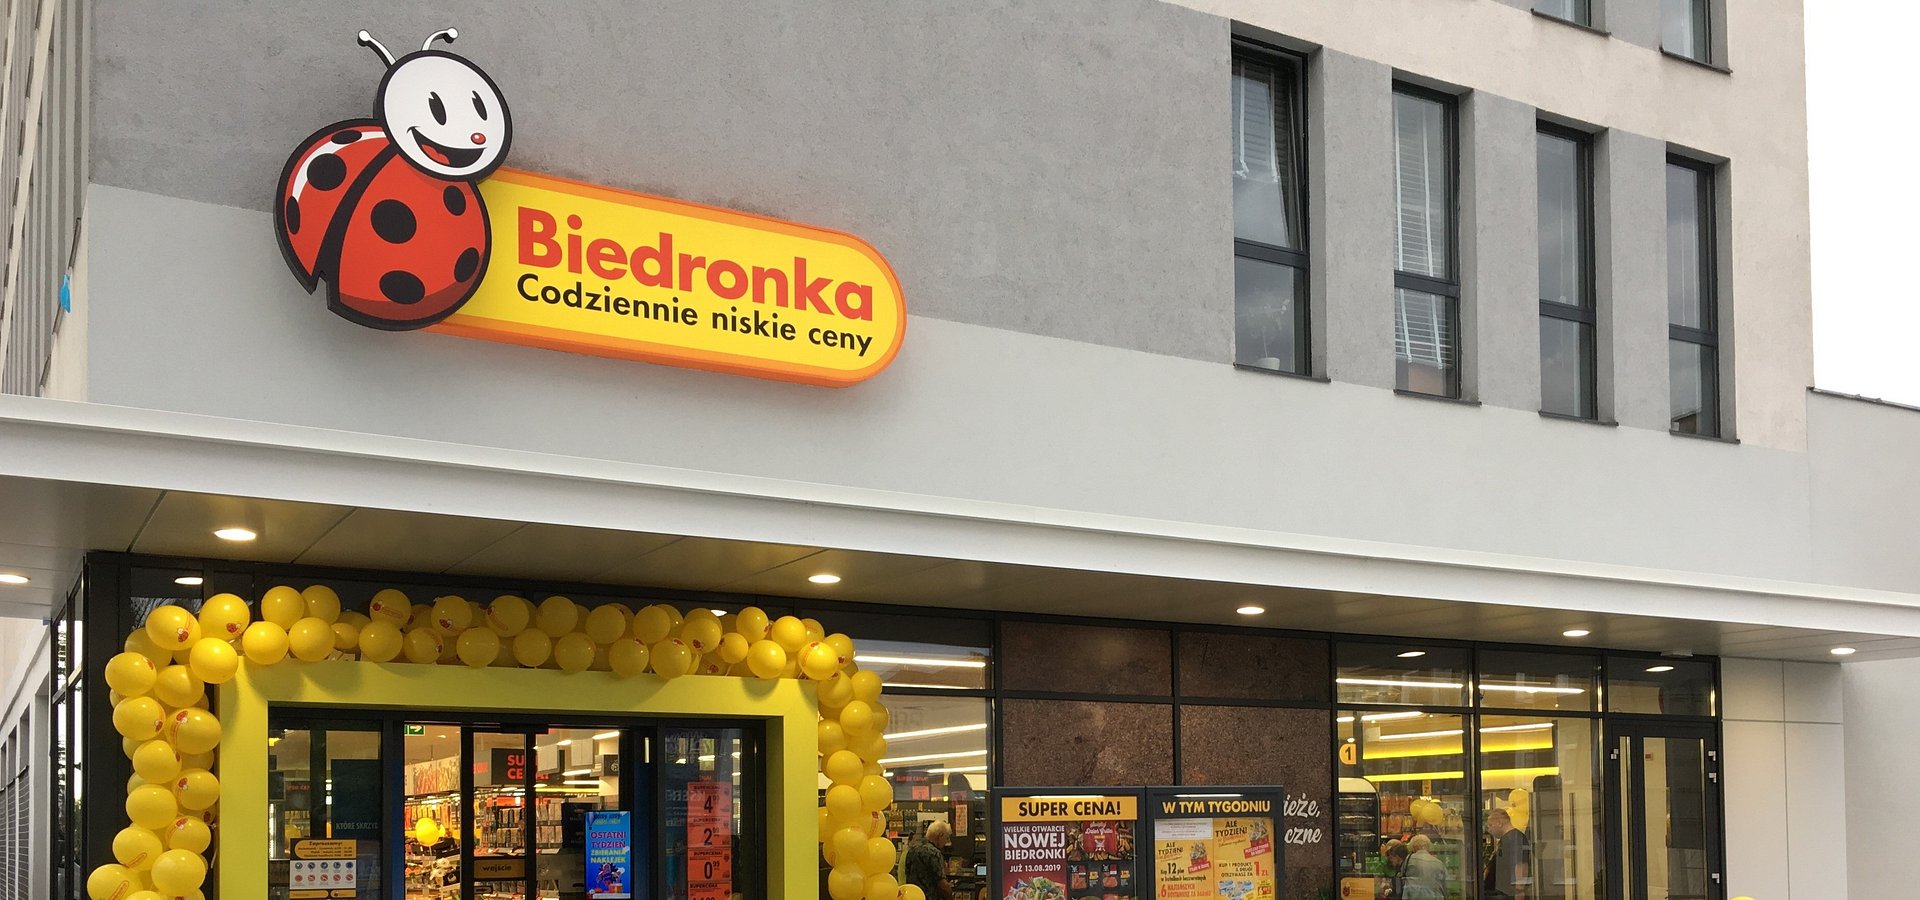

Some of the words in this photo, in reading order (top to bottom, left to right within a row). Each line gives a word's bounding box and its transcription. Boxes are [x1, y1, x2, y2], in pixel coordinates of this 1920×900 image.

[517, 205, 873, 322] Biedronka
[517, 273, 698, 326] Codziennie
[712, 306, 796, 341] niskie
[808, 327, 873, 357] ceny
[1345, 747, 1351, 761] 1
[1019, 801, 1068, 816] SUPER
[1073, 801, 1121, 815] CENA!
[1162, 801, 1176, 814] W
[1179, 801, 1205, 814] TYM
[1208, 800, 1271, 813] TYGODNIU
[1283, 792, 1321, 818] ieże,
[1225, 820, 1238, 828] ALE
[591, 831, 626, 839] OSTATNI
[1004, 832, 1066, 849] NOWEJ
[1004, 848, 1066, 860] BIEDRONKI
[1009, 863, 1023, 873] JUŻ
[1024, 864, 1062, 873] 13.08.2019
[1168, 862, 1177, 875] 12
